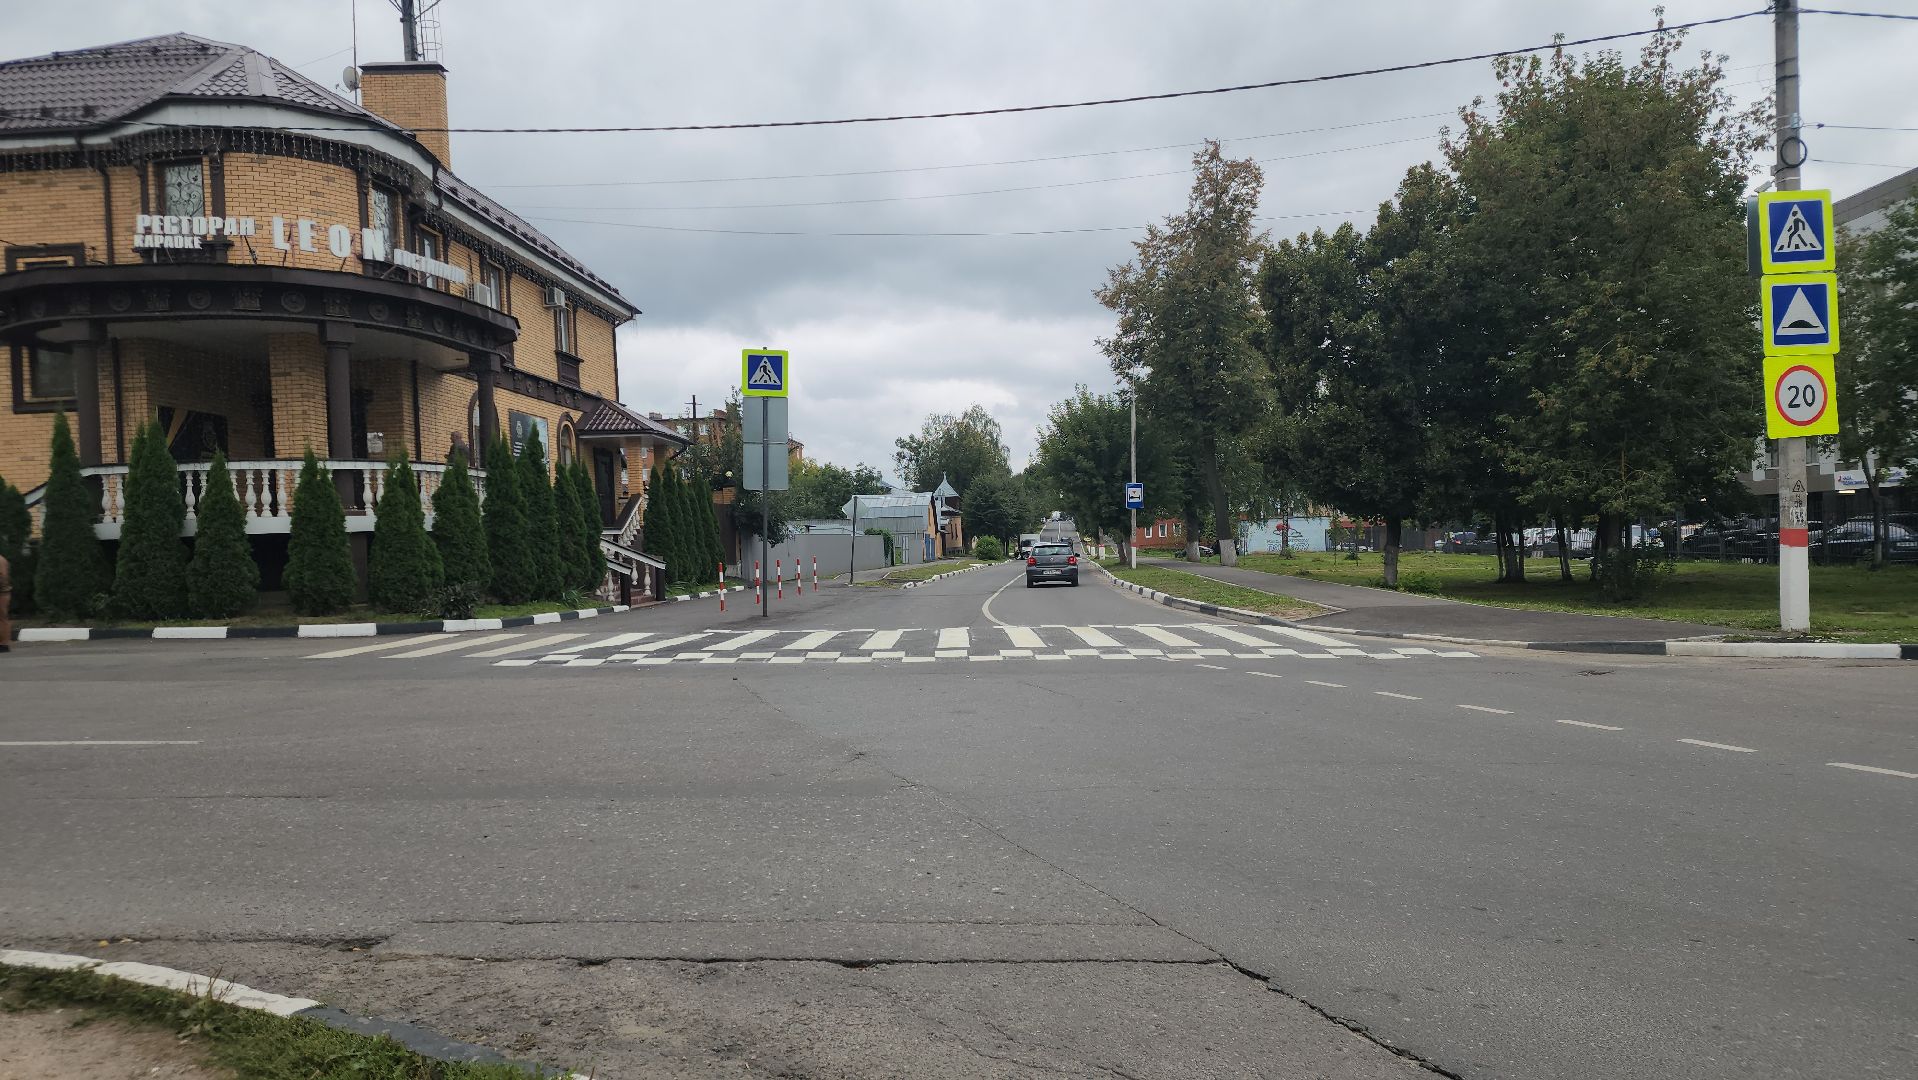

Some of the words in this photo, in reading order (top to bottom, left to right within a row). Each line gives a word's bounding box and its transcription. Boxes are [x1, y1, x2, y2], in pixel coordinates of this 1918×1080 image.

[136, 215, 256, 236] РЕСТОРАН
[134, 233, 203, 249] КАРАОКЕ
[272, 216, 385, 261] LEON
[1788, 384, 1816, 408] 20
